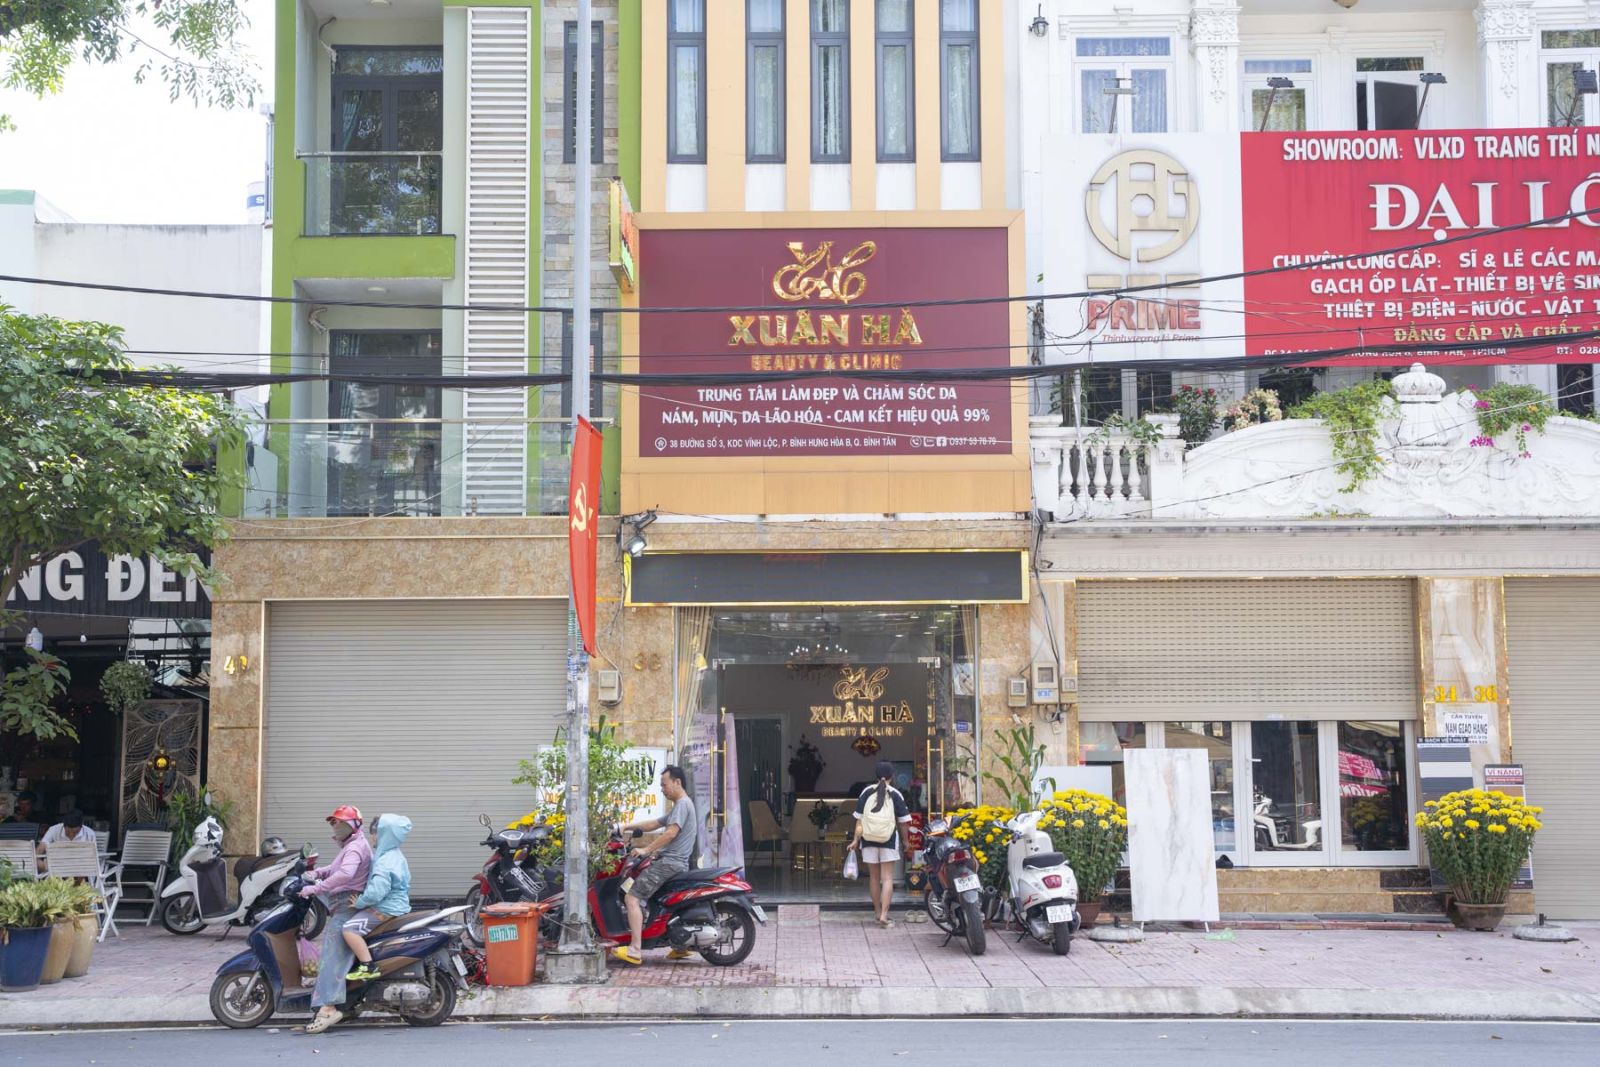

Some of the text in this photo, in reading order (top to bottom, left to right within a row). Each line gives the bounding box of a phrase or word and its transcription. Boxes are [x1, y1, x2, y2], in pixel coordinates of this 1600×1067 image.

[1282, 137, 1403, 161] SHOWROOM:
[1414, 136, 1465, 159] VLXD
[1474, 135, 1540, 158] TRANG
[1546, 128, 1578, 157] TRÍ
[1369, 182, 1499, 241] ĐẠI
[1273, 250, 1344, 270] CHUYÊN
[1398, 247, 1441, 269] CẤP:
[1483, 253, 1496, 268] &
[1531, 247, 1570, 267] CÁC
[1310, 277, 1363, 296] GẠCH
[1369, 272, 1396, 293] ỐP
[1401, 273, 1438, 293] LÁT
[1454, 270, 1508, 292] THIẾT
[1515, 275, 1534, 294] BỊ
[1086, 299, 1201, 330] PRIME
[1384, 302, 1403, 320] BỊ
[1412, 297, 1455, 320] ĐIỆN
[1472, 296, 1526, 317] NƯỚC
[1544, 295, 1584, 317] VẬT
[728, 306, 923, 346] XUÂN HÀ
[751, 354, 817, 371] BEAUTY
[839, 352, 903, 371] CLINIC
[697, 383, 957, 404] TRUNG TÂM LÀM ĐẸP VÀ CHĂM SÓC DA
[662, 406, 699, 426] NÁM,
[702, 410, 737, 428] MỤN,
[742, 410, 761, 424] DA
[765, 406, 791, 424] LÃO
[794, 406, 823, 424] HÓA
[834, 409, 864, 423] CAM
[868, 404, 893, 423] KẾT
[897, 406, 927, 426] HIỆU
[931, 405, 959, 425] QUẢ
[963, 408, 990, 423] 99%
[669, 439, 678, 448] 38
[680, 436, 705, 449] ĐƯỜNG
[707, 435, 717, 448] SỐ
[763, 436, 780, 450] LỘC,
[782, 439, 788, 447] P.
[790, 436, 807, 447] BÌNH
[808, 436, 829, 447] HƯNG
[863, 435, 881, 447] BÌNH
[881, 436, 897, 446] TÂN
[810, 700, 913, 723] XUÂN HÀ
